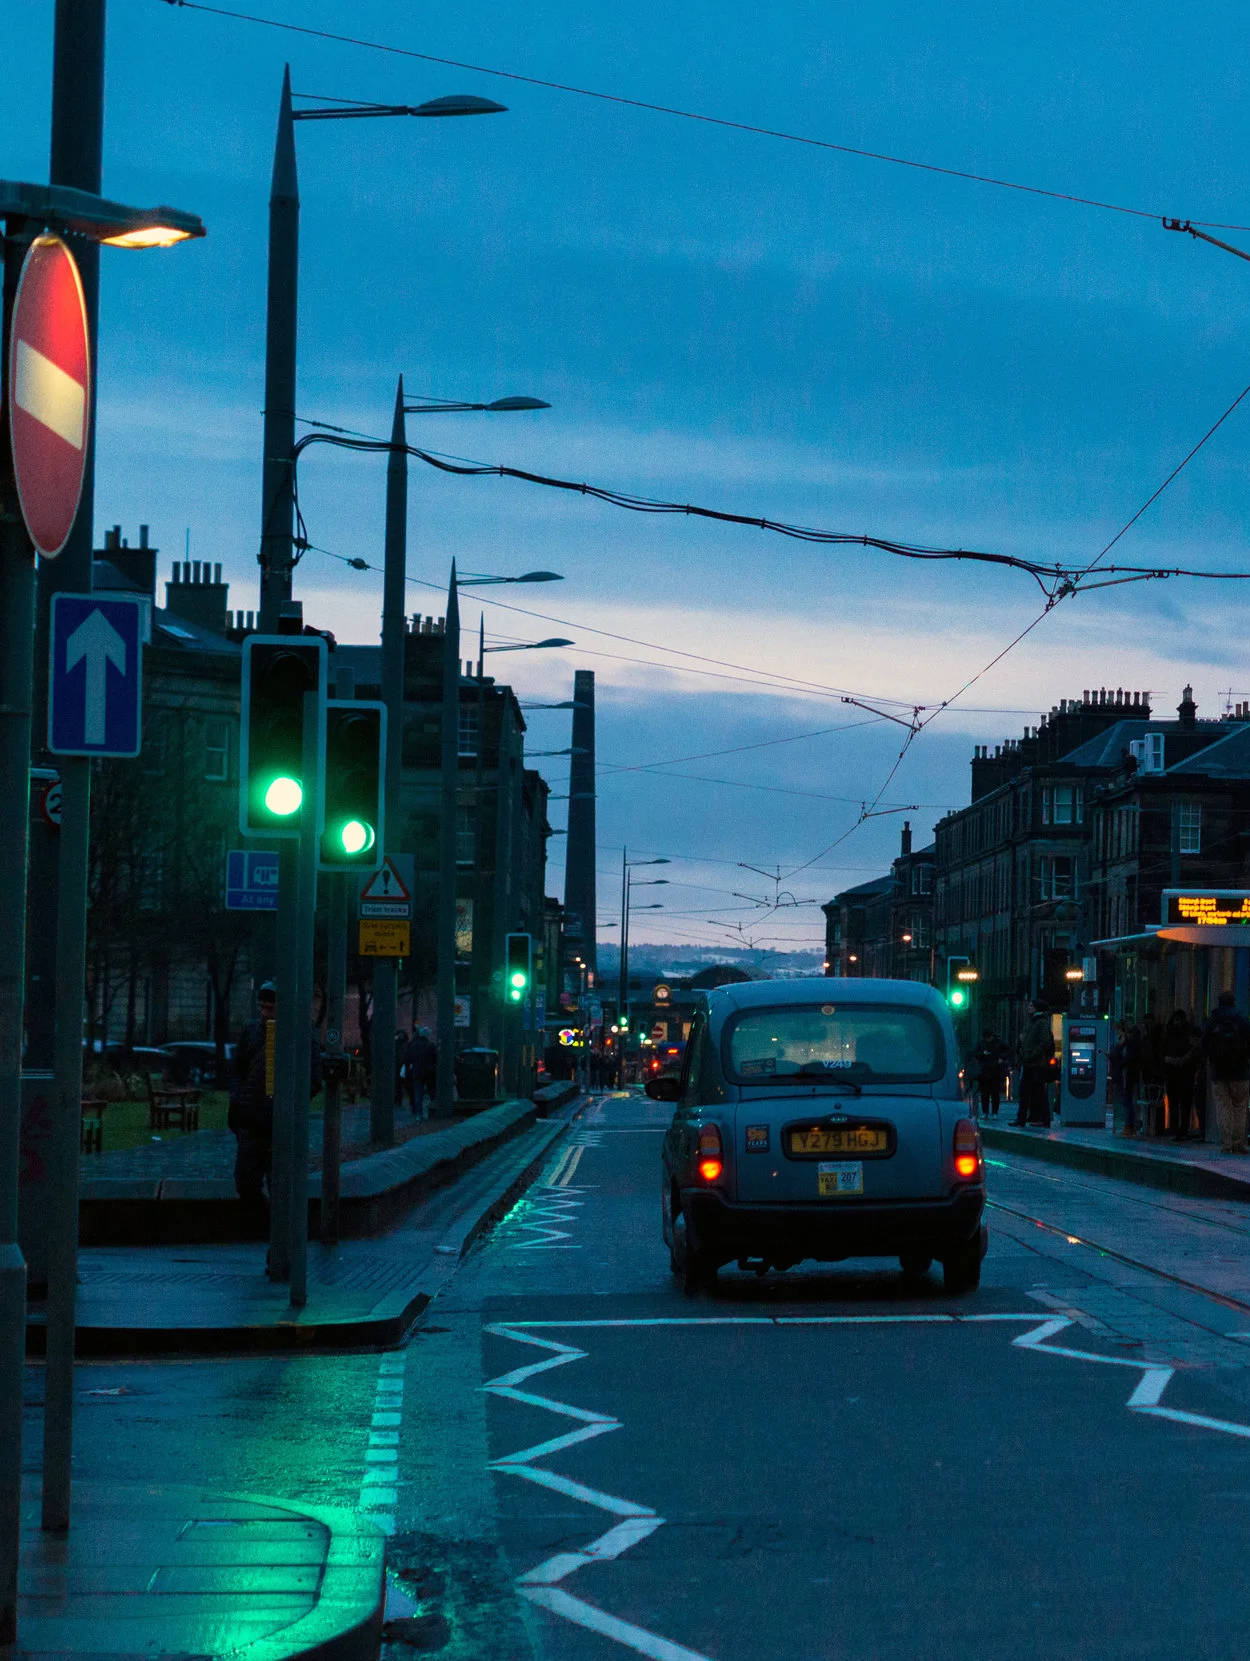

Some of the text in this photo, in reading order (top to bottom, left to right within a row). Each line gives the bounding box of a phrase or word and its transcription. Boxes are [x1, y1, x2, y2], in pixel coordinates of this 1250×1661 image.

[800, 1132, 880, 1148] Y279 HGJ
[841, 1172, 857, 1182] 207
